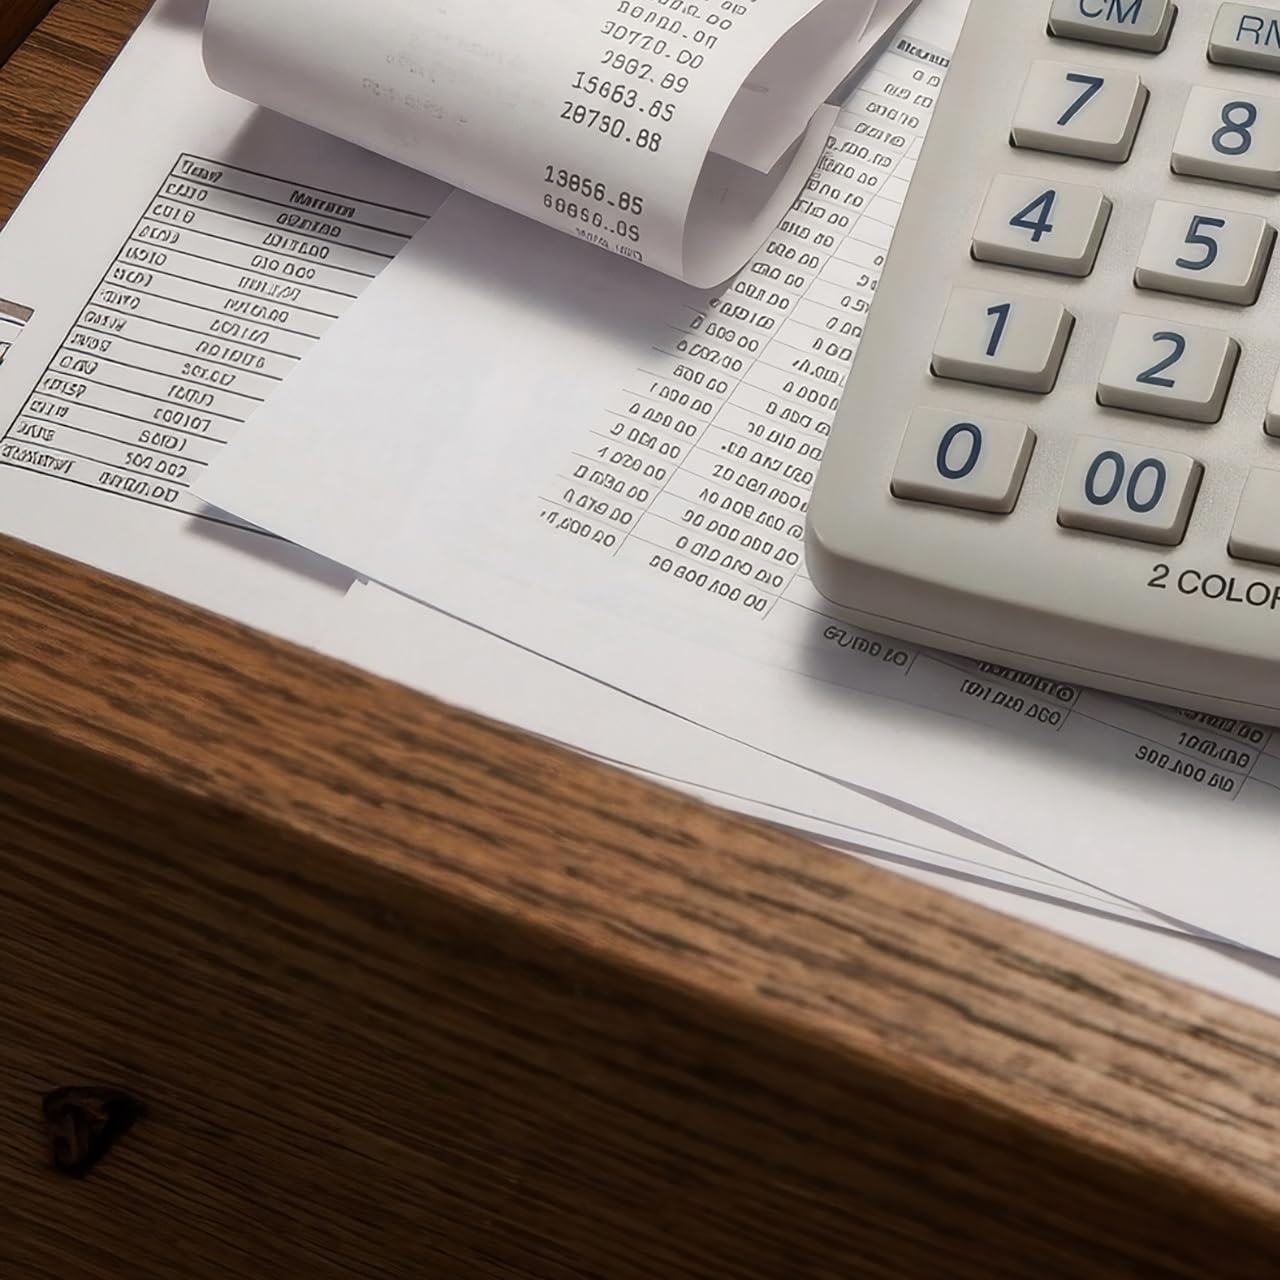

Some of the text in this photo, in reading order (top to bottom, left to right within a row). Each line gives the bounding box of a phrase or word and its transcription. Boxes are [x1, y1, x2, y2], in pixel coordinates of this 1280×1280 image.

[1057, 73, 1104, 126] 7
[1211, 101, 1257, 155] 8
[1009, 189, 1056, 242] 4
[1176, 215, 1226, 270] 5
[985, 303, 1011, 357] 1
[1135, 331, 1186, 388] 2
[936, 422, 983, 480] 0
[1083, 450, 1167, 514] 00
[1147, 563, 1170, 588] 2
